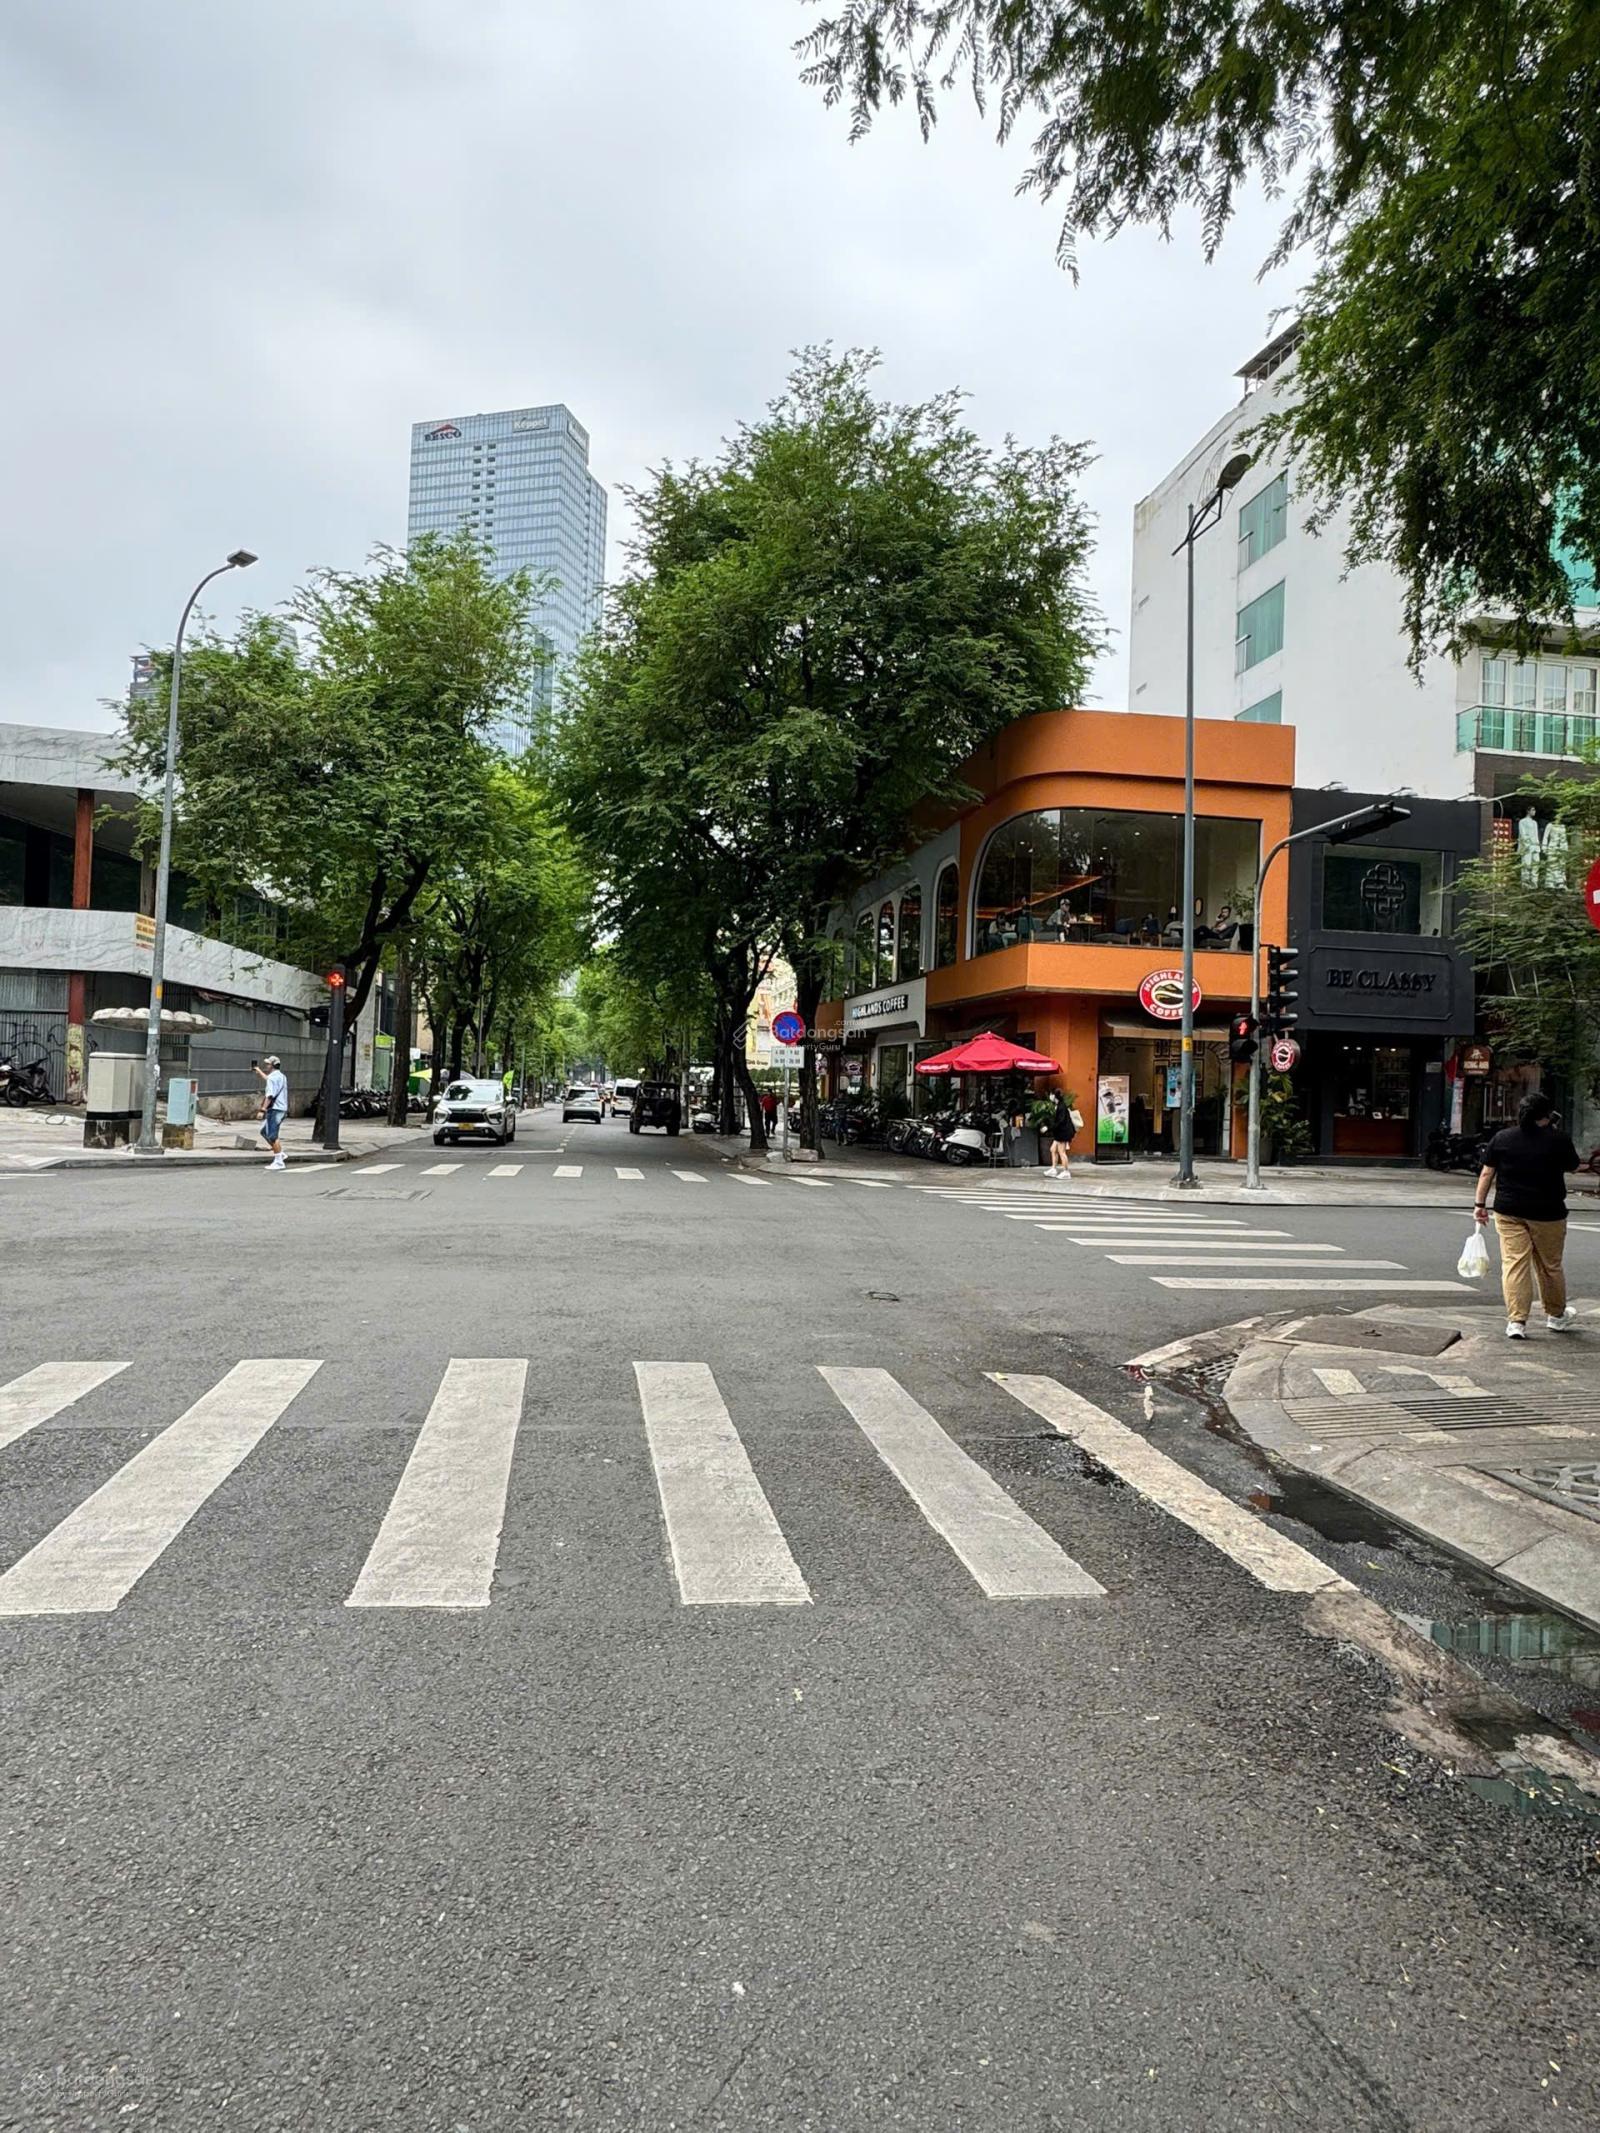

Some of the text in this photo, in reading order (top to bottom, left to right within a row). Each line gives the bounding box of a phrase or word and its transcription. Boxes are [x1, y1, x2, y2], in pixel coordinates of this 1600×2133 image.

[1326, 969, 1436, 992] BE CLASSY
[882, 996, 905, 1012] COFFEE
